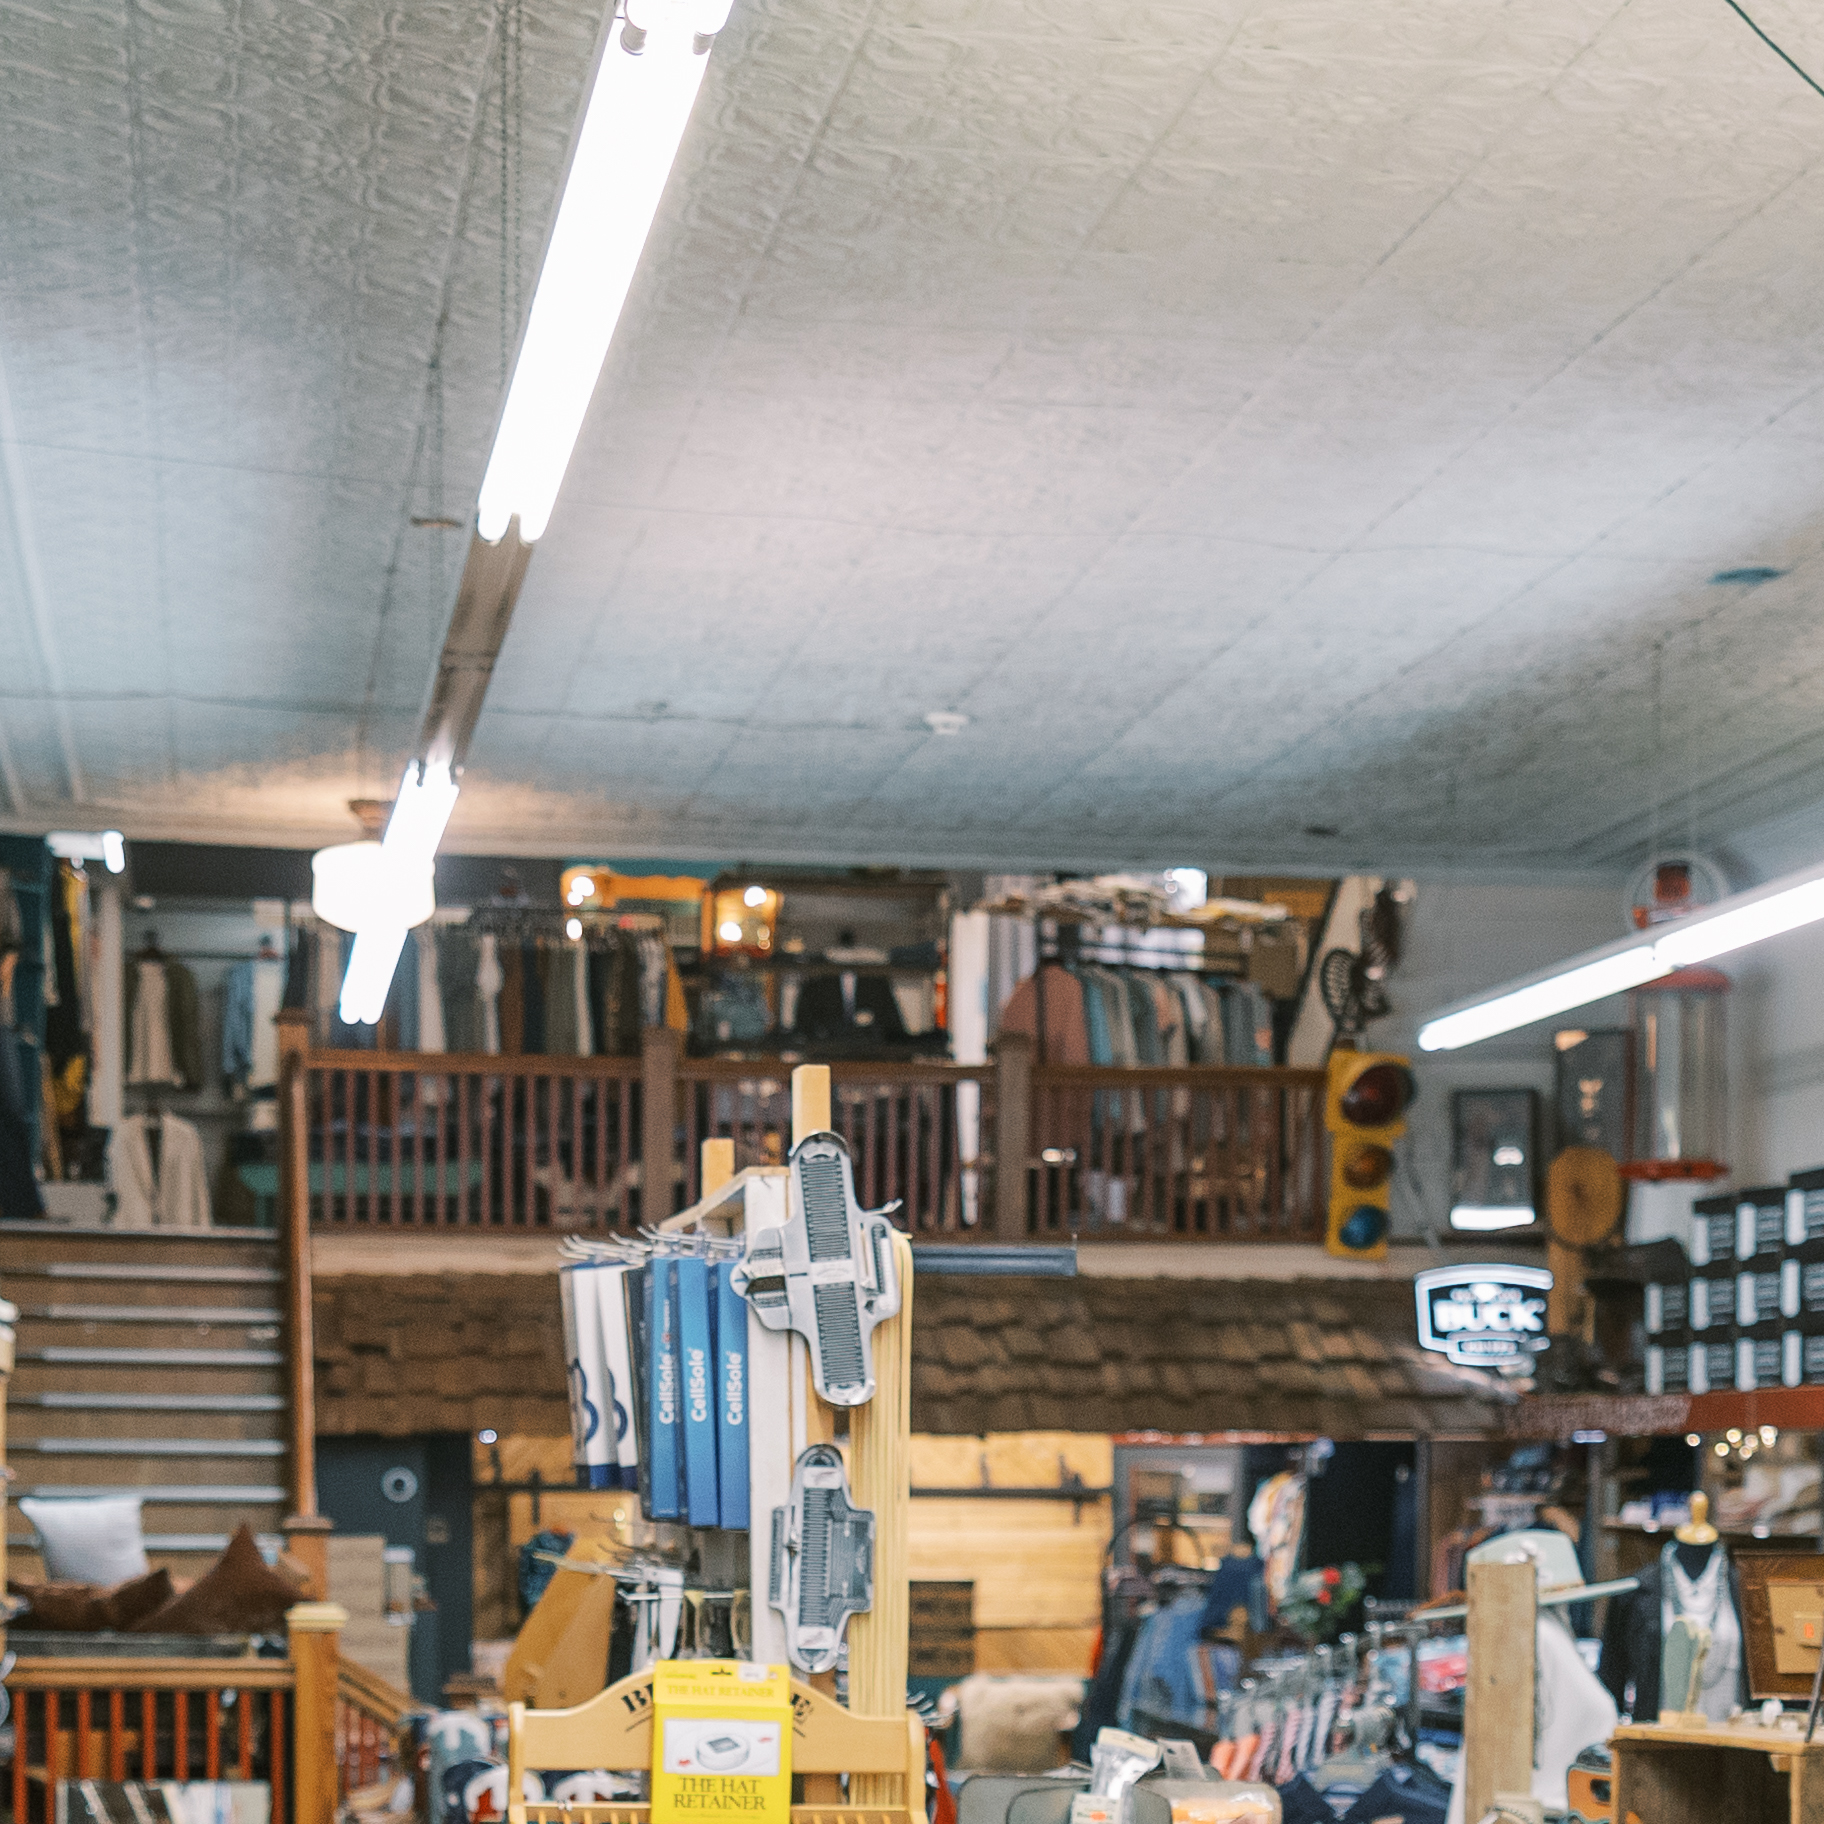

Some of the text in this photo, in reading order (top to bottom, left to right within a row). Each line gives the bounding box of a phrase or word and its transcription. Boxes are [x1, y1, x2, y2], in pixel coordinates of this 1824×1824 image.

[687, 1348, 708, 1423] CellSole
[726, 1352, 743, 1426] CellSole
[667, 1684, 775, 1697] THE HAT RETAINER
[678, 1777, 762, 1794] THE HAT
[673, 1793, 766, 1810] RETAINER
